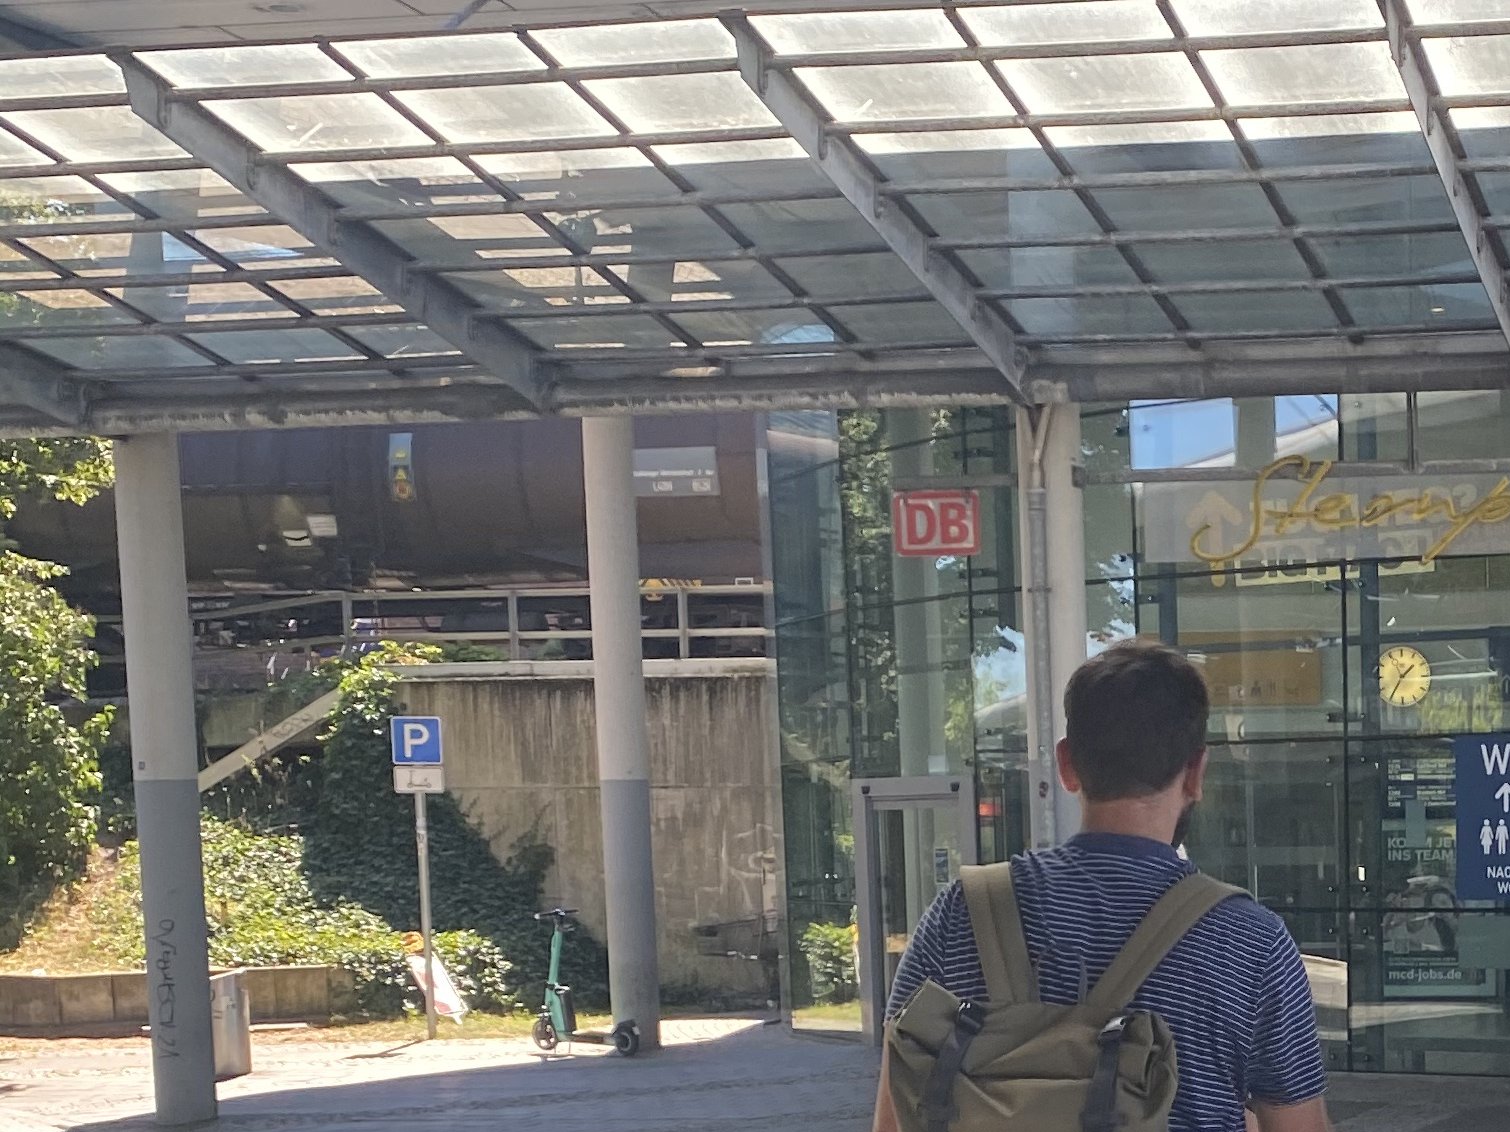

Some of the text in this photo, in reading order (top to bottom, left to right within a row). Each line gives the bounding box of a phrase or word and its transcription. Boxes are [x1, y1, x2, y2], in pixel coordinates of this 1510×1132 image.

[904, 500, 973, 549] DB
[404, 723, 430, 758] P
[1387, 836, 1432, 849] KOM
[1387, 850, 1412, 862] INS
[1388, 968, 1462, 982] mcd-jobs.de
